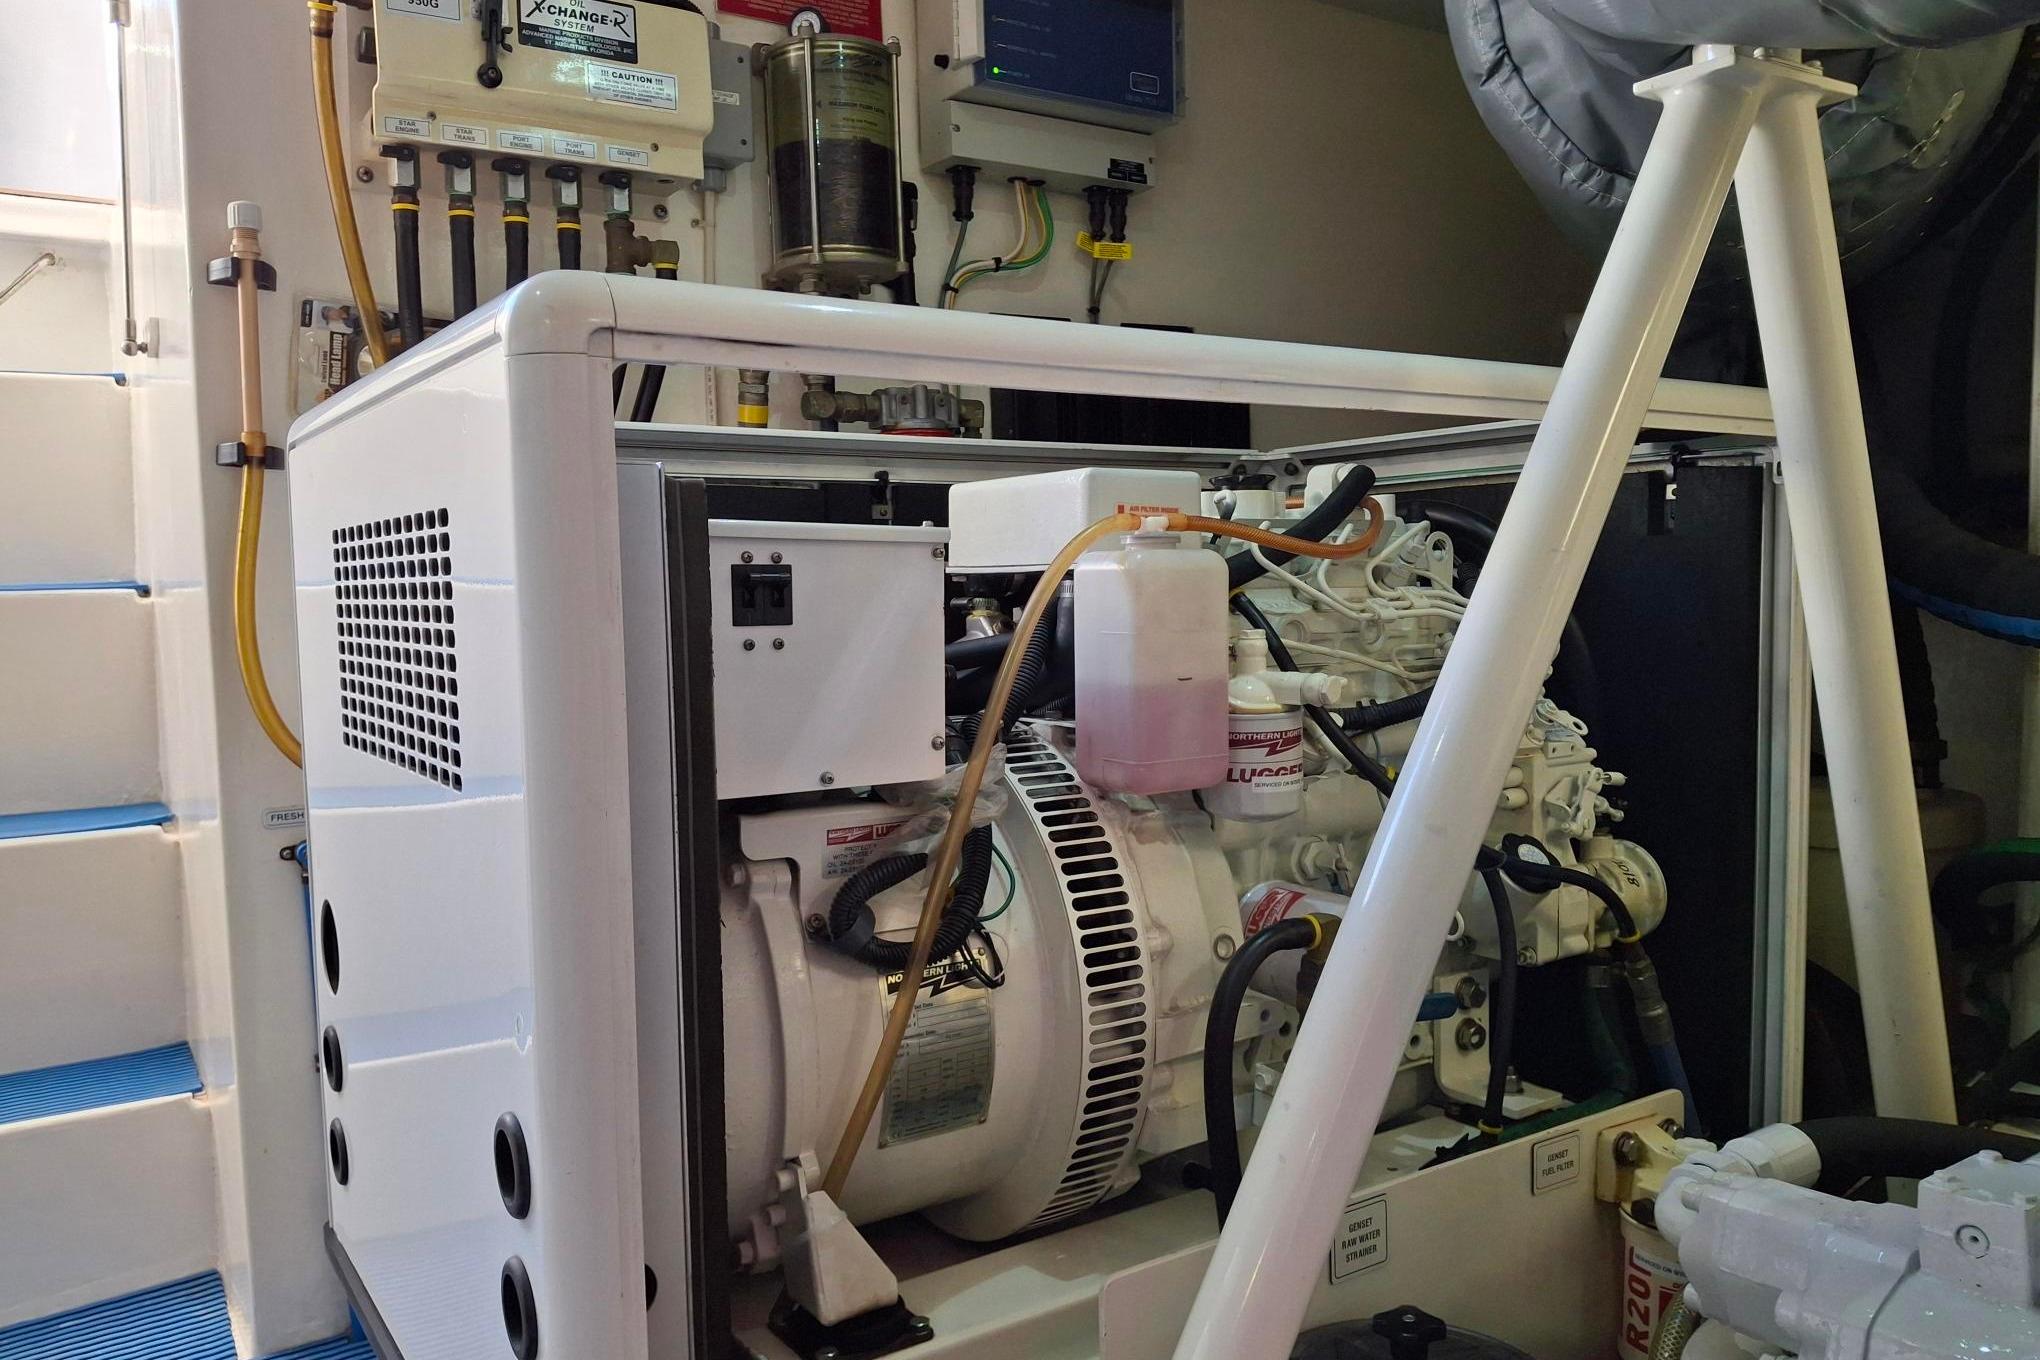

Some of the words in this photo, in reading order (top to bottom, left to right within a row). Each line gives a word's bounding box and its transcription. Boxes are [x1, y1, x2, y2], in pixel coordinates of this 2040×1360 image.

[554, 18, 595, 33] SYSTEM
[521, 28, 554, 39] ADVANCED
[561, 30, 594, 41] PRODUCTS
[594, 36, 619, 46] DIVISION
[590, 46, 614, 56] FLORIDA
[611, 71, 653, 84] CAUTION
[395, 125, 419, 134] ENGINE
[510, 140, 533, 149] ENGINE
[617, 150, 640, 158] GENSET
[1141, 505, 1160, 513] FILTER
[270, 812, 305, 822] FRESH
[1547, 1149, 1569, 1162] GENSET
[1542, 1167, 1555, 1177] FUEL
[1556, 1160, 1574, 1172] FILTER
[1348, 1217, 1373, 1233] GENSET
[1341, 1237, 1357, 1250] RAW
[1358, 1229, 1381, 1244] WATER
[1345, 1244, 1377, 1263] STRAINER
